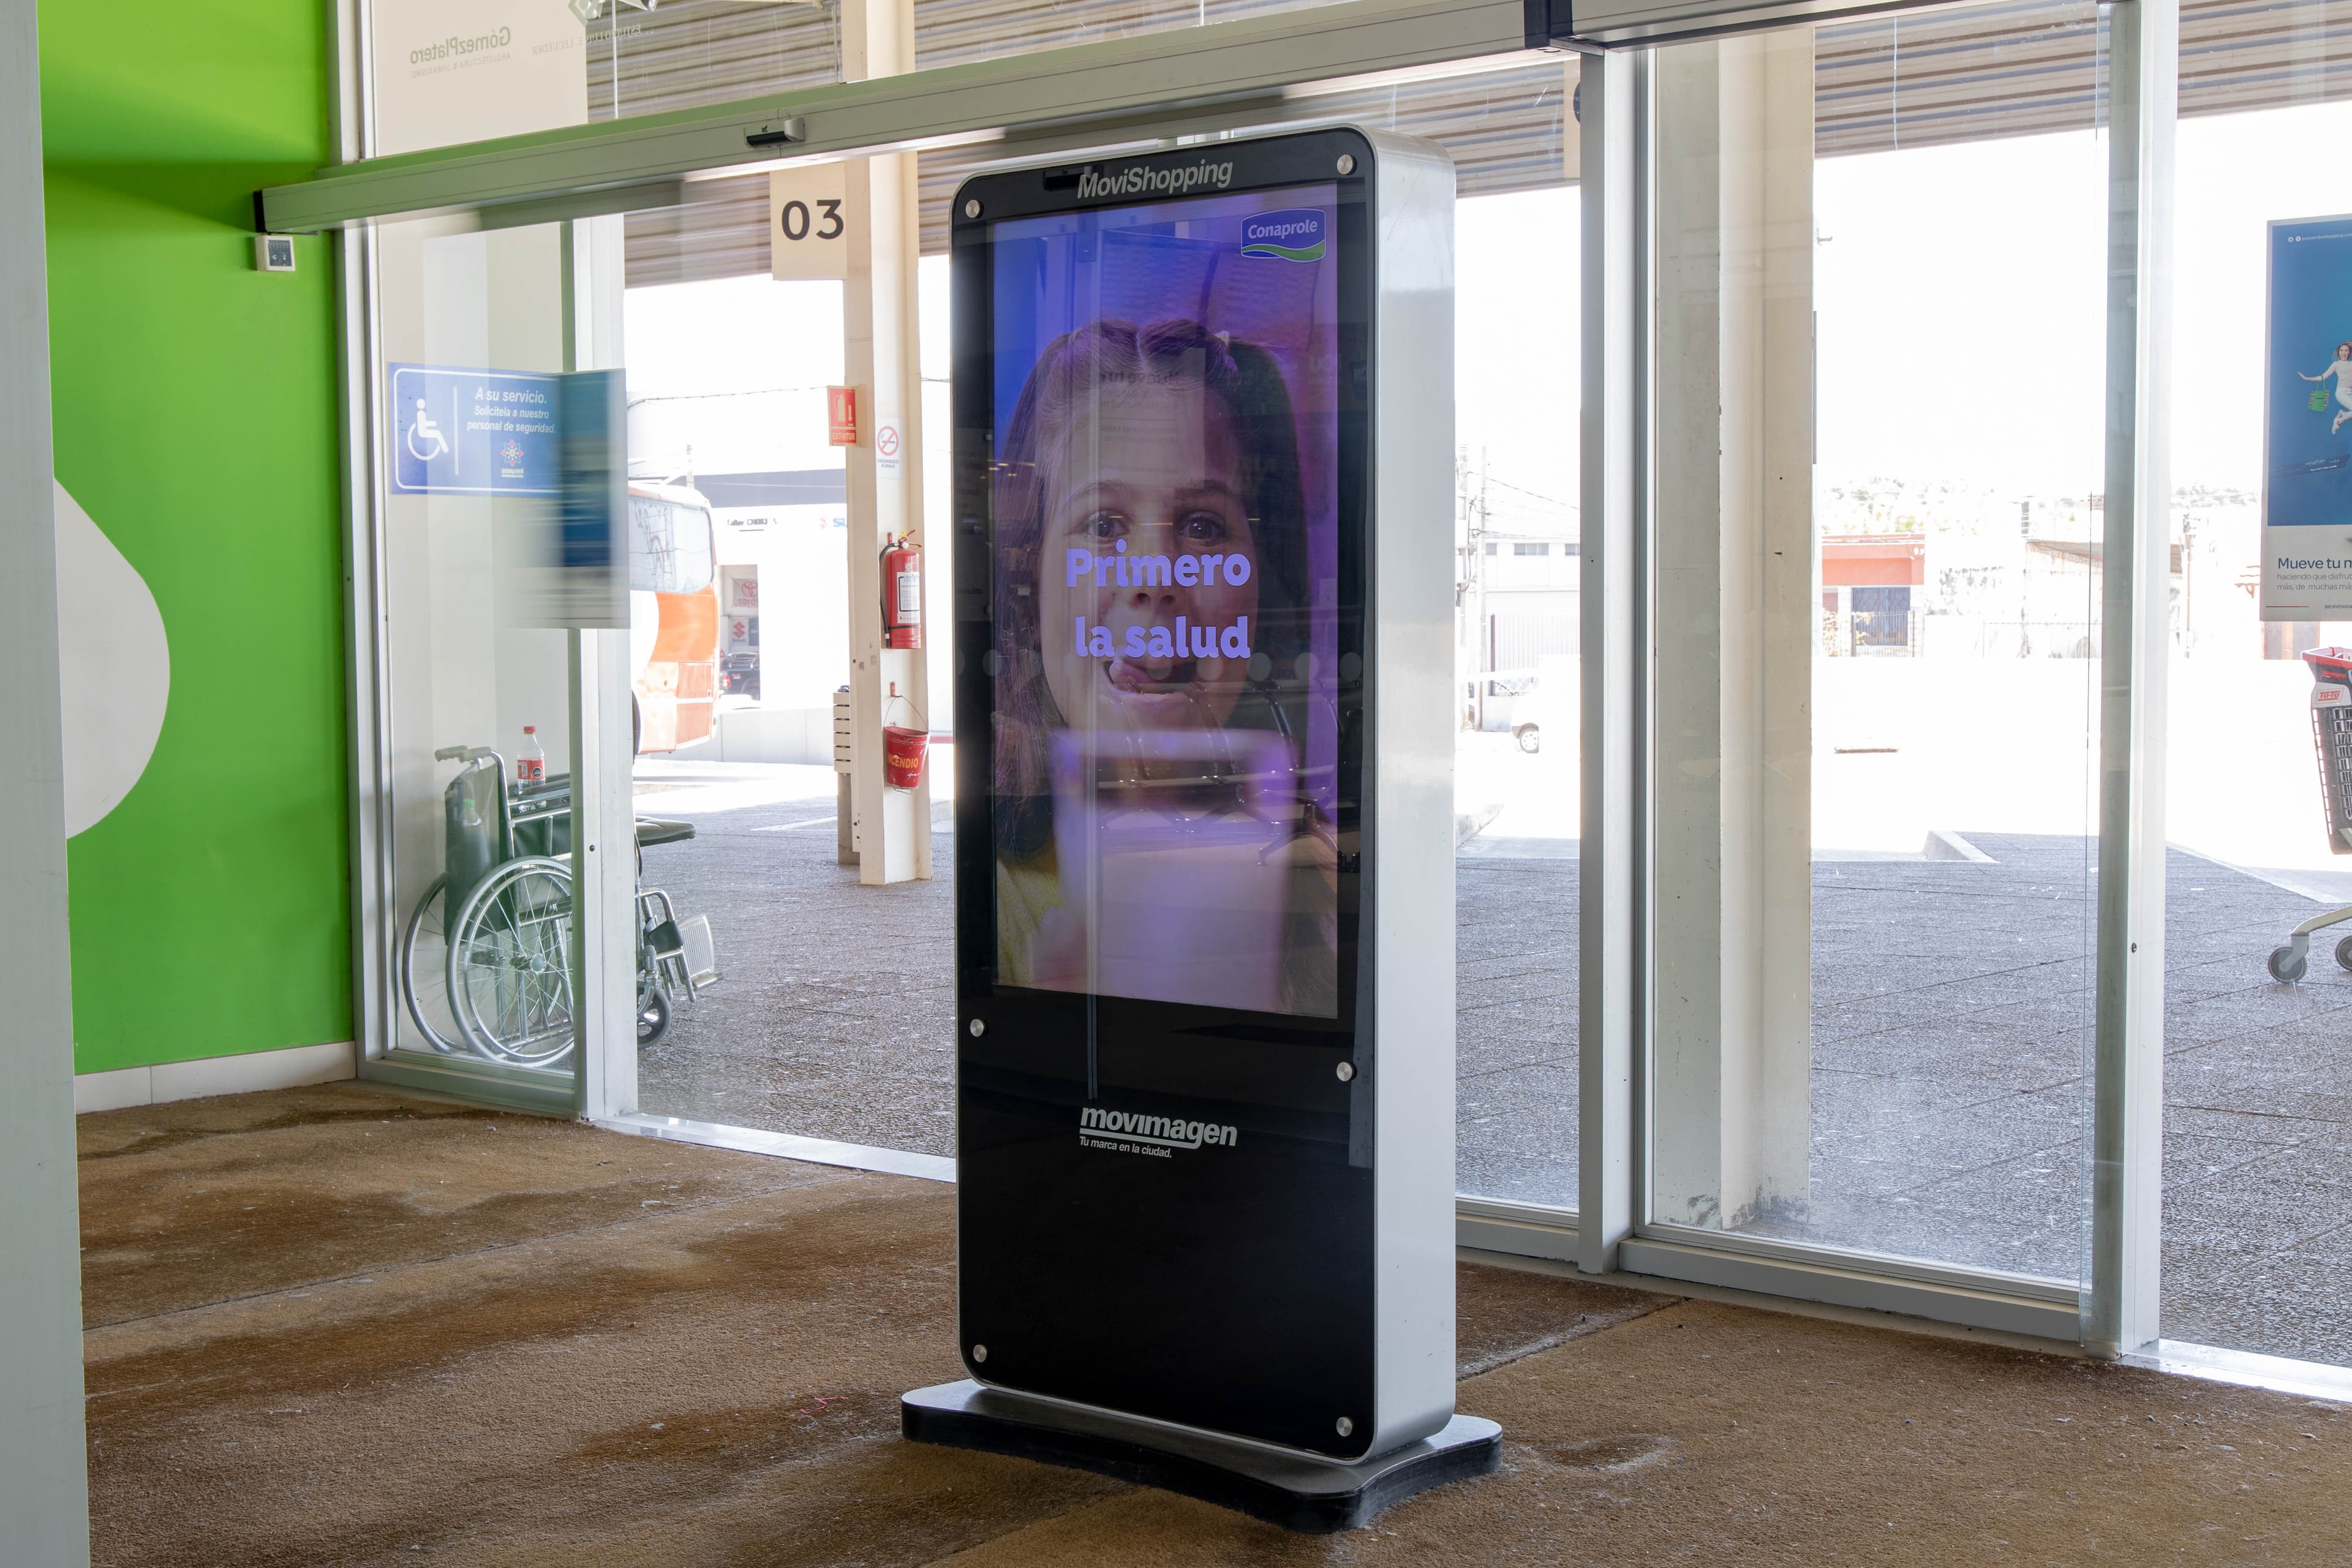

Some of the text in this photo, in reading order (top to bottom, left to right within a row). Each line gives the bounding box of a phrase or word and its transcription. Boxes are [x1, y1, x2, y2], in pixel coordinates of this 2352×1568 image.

[1077, 159, 1234, 199] MoviShopping
[782, 199, 844, 241] 03
[1248, 219, 1318, 239] Conaprole
[475, 386, 547, 404] A su servicio.
[519, 409, 549, 419] nuestro
[467, 420, 502, 432] personal
[503, 421, 513, 431] de
[832, 432, 856, 441] EXTINTOR
[1066, 538, 1251, 587] Primero
[2278, 557, 2324, 569] Mueve
[2326, 558, 2340, 569] tu
[1076, 615, 1251, 658] la salud
[1080, 1107, 1237, 1149] movimagen
[1079, 1136, 1172, 1158] Tu marca en la ciudad.
